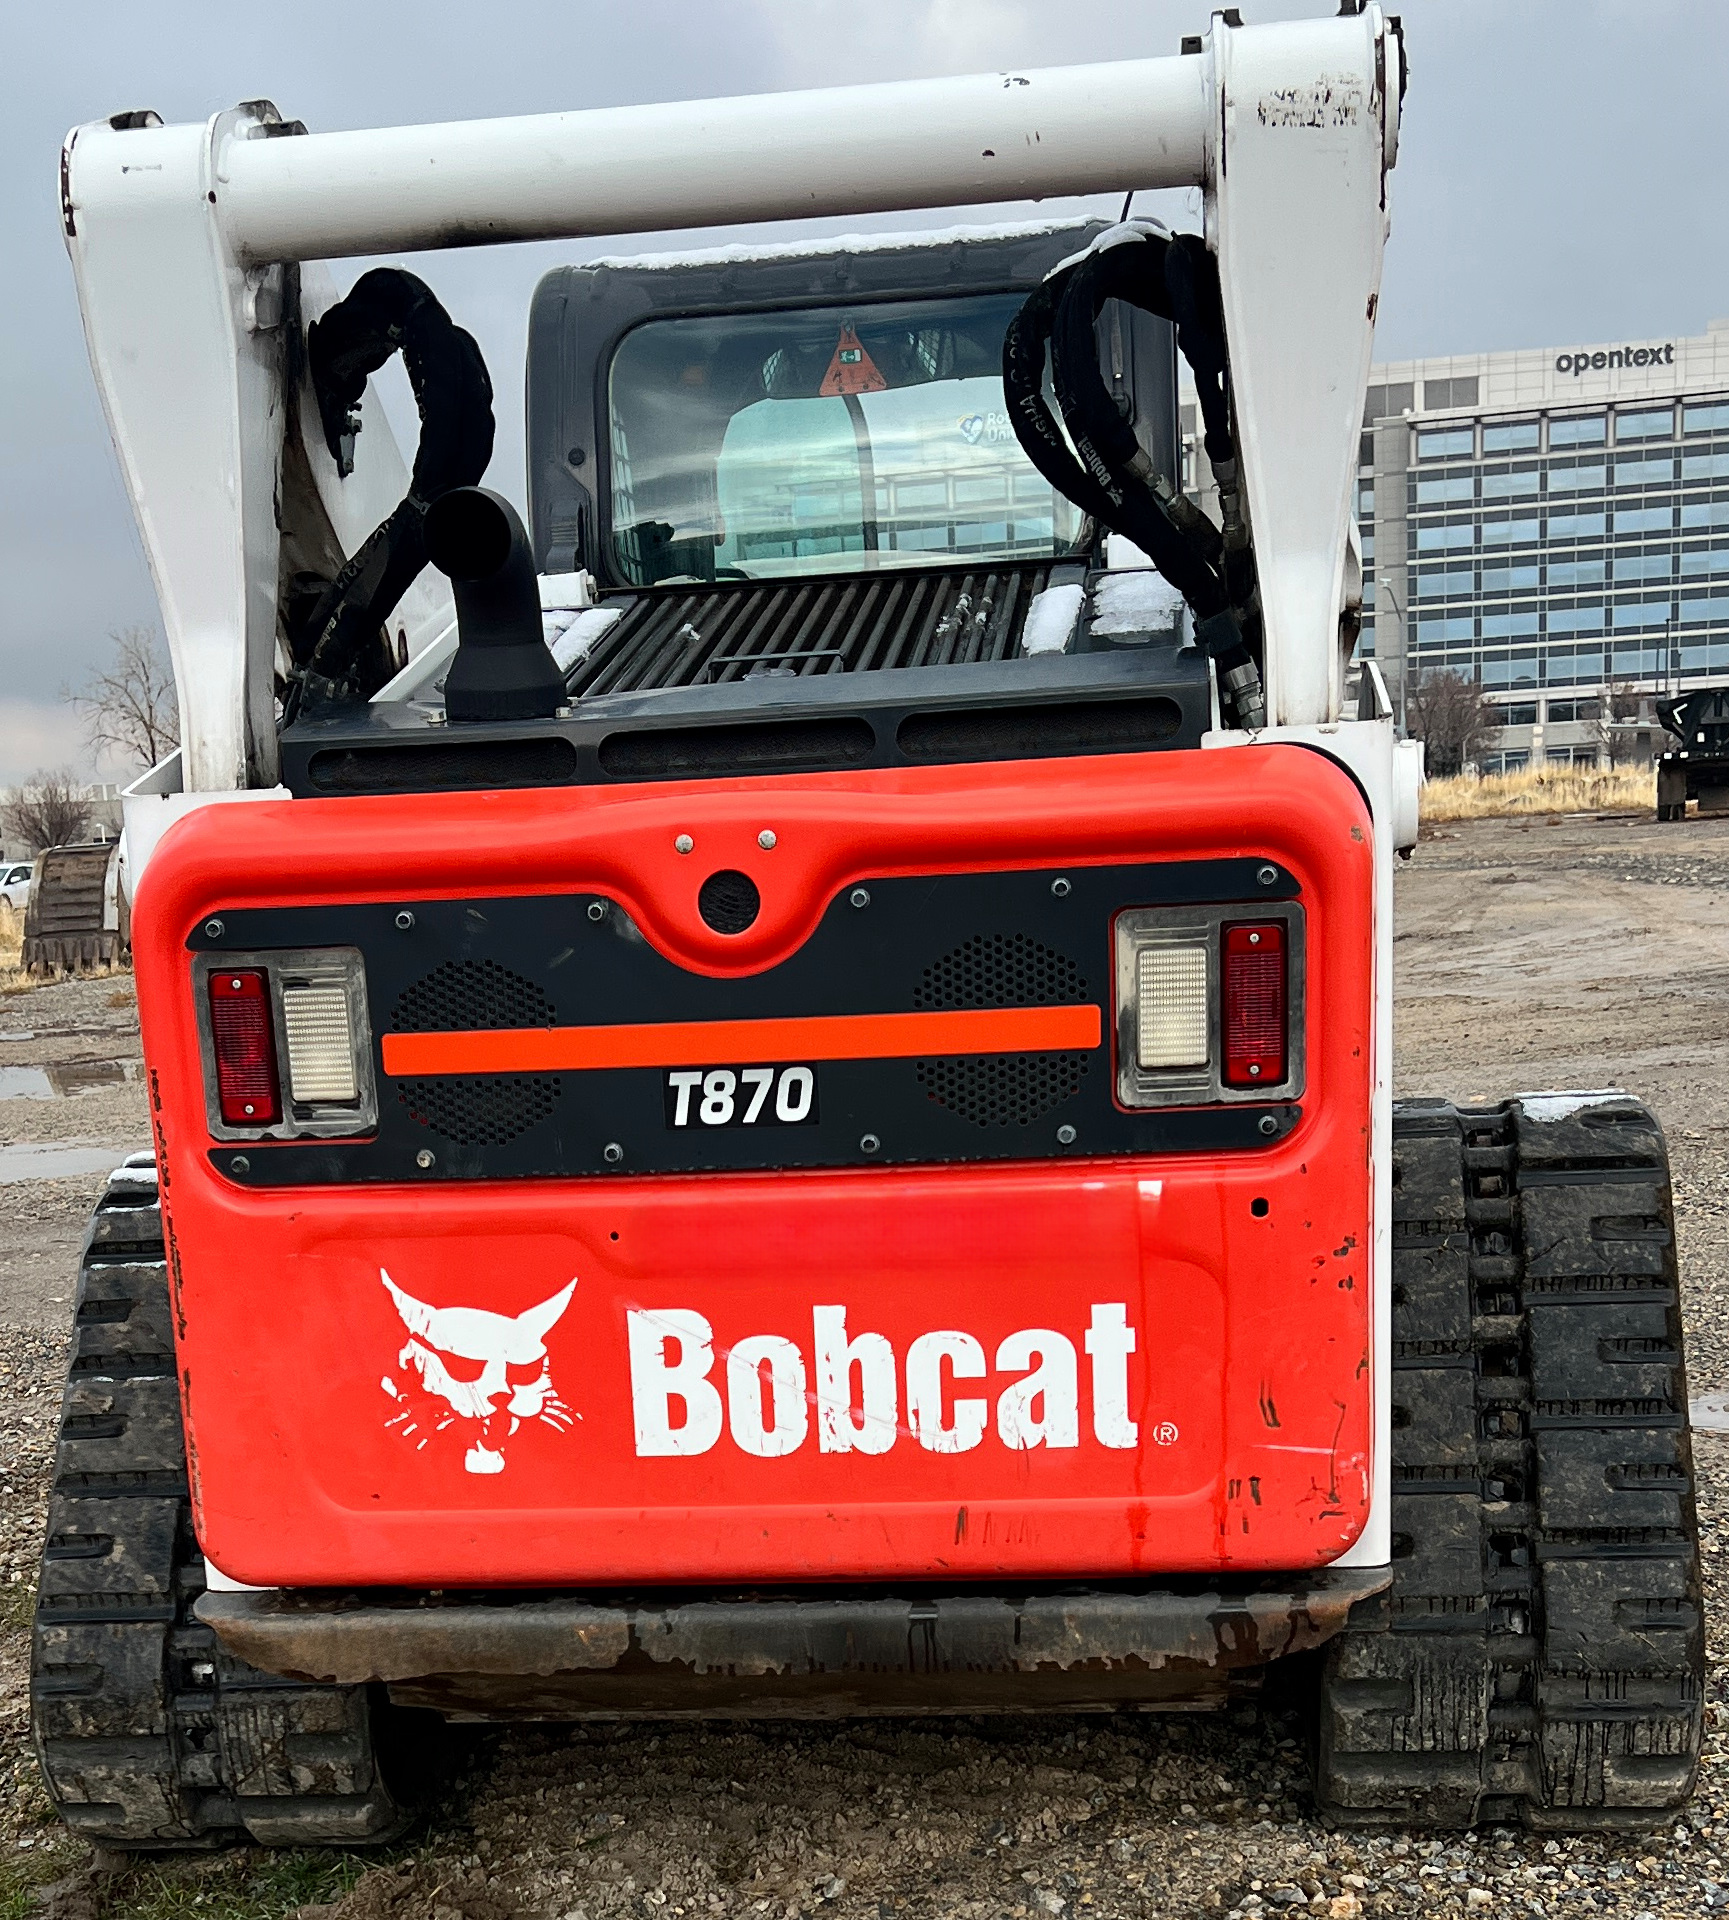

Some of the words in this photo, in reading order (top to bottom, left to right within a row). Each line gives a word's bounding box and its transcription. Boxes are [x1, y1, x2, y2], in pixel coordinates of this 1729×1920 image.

[1556, 343, 1674, 377] opentext
[1077, 435, 1112, 487] Bobcat
[668, 1066, 814, 1126] T870
[626, 1302, 1138, 1458] Bobcat
